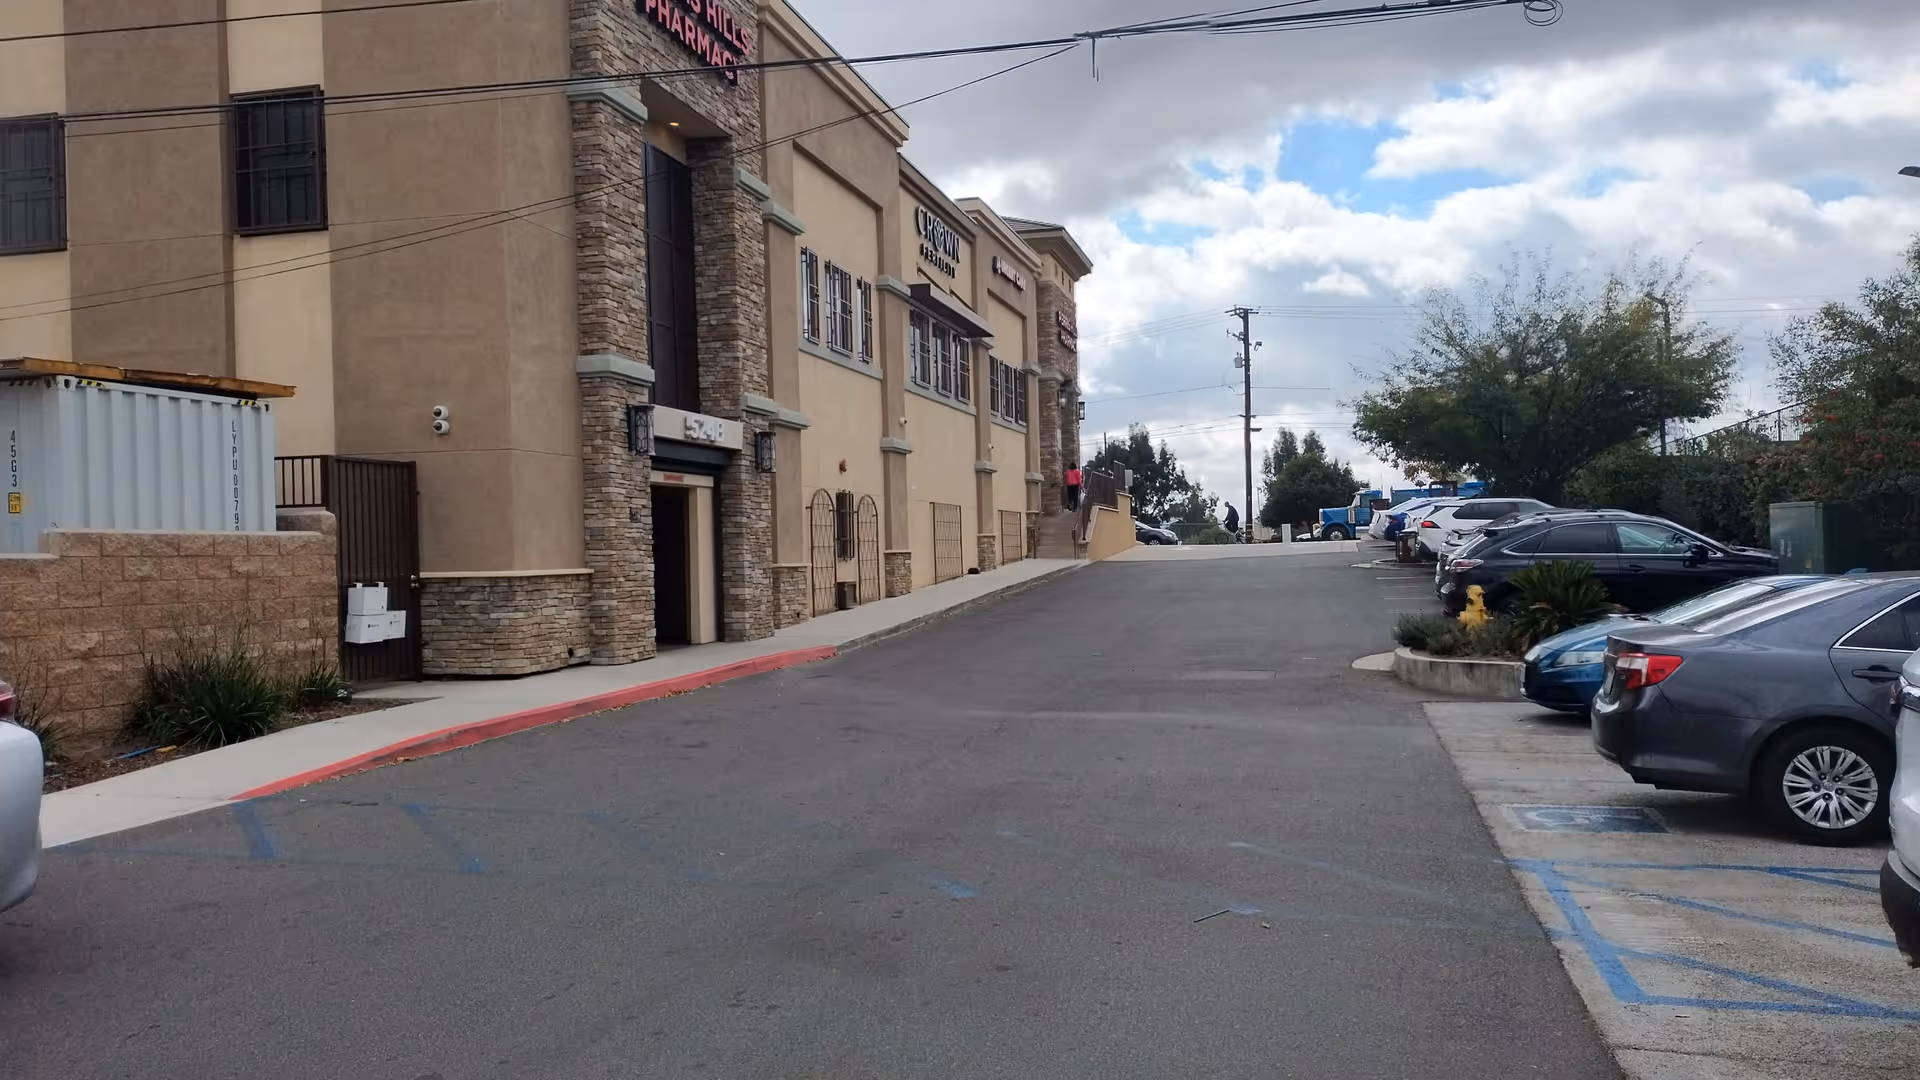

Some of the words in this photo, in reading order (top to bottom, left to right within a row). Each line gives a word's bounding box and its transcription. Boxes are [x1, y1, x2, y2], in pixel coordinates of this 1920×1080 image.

[706, 0, 751, 55] HILLS
[915, 205, 960, 263] CROWN
[10, 430, 18, 487] 45G3
